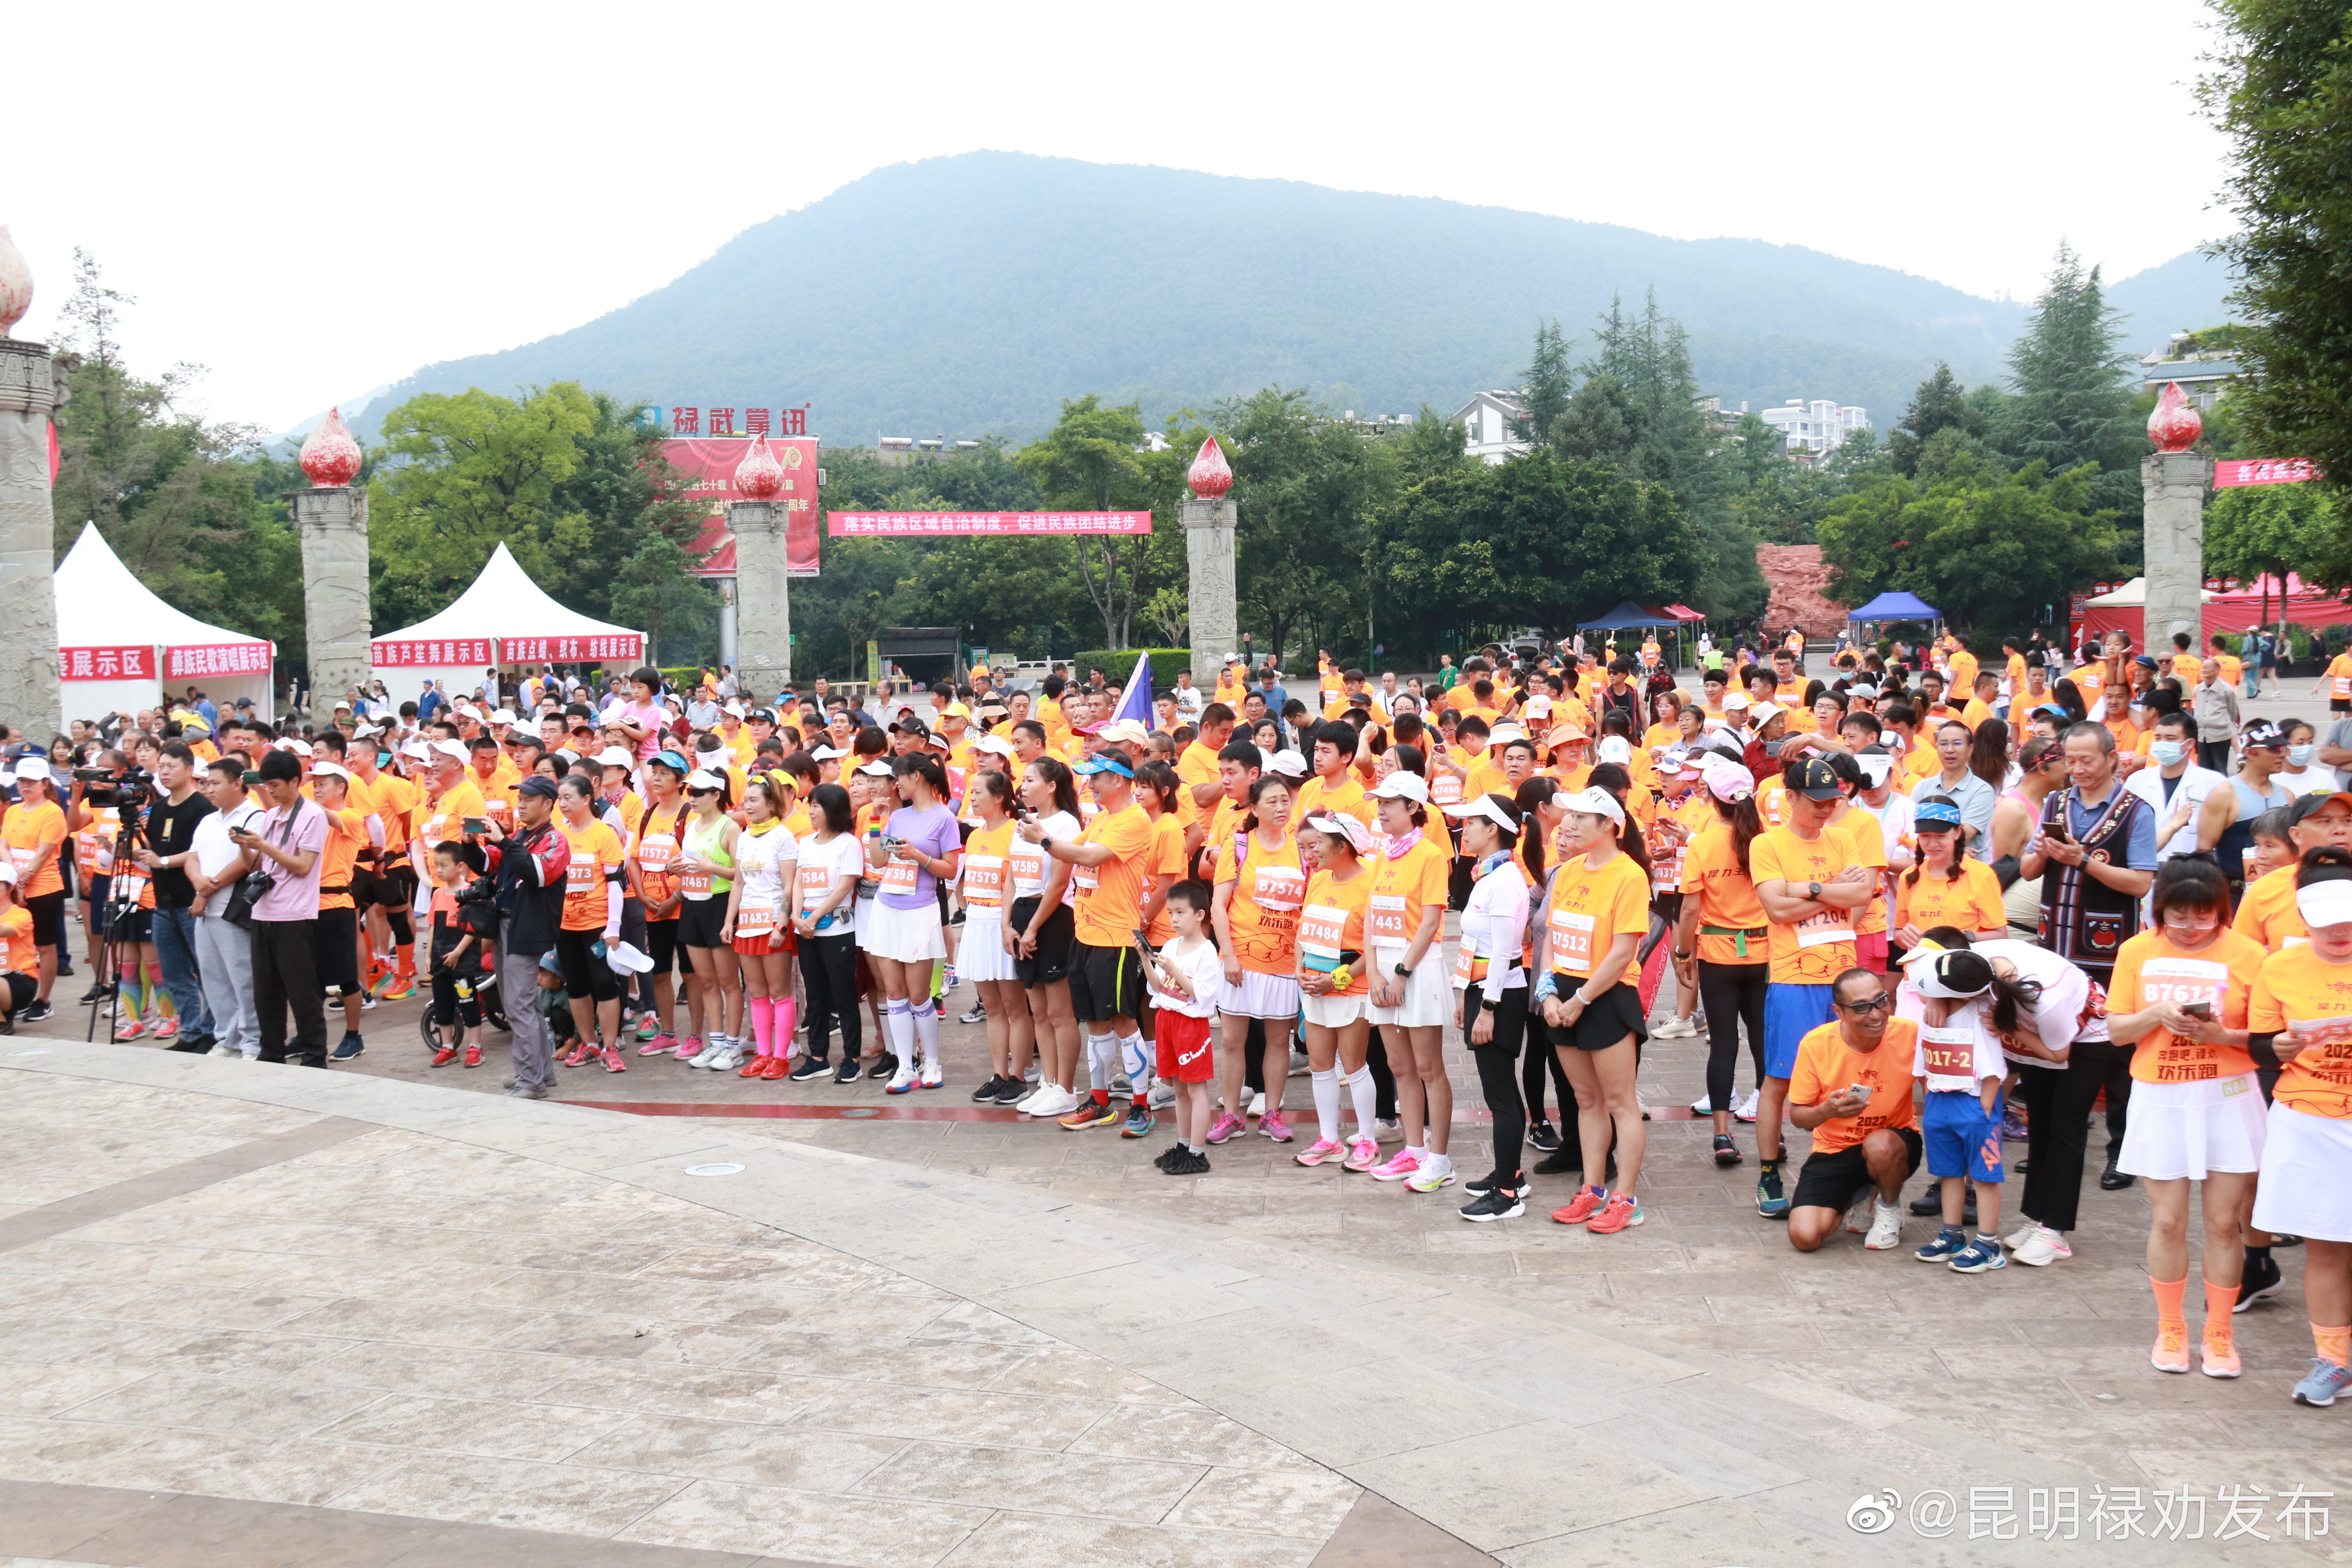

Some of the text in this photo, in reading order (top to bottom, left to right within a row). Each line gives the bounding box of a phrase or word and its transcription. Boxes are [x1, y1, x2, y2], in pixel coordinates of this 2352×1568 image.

[673, 407, 806, 434] 禄武掌讯
[373, 642, 486, 664] 苗族芦笙舞展示区
[507, 638, 636, 661] 苗族点蜡、织布、纺线展示区
[172, 646, 268, 676] 彝族民歌演唱展示区
[1434, 786, 1460, 795] B7490
[639, 846, 669, 859] B7572
[1012, 860, 1038, 873] B7589
[1707, 868, 1743, 878] 犀力王
[885, 867, 914, 881] B7598
[964, 870, 998, 884] B7579
[682, 875, 708, 888] B7487
[1258, 880, 1303, 898] B7574
[739, 912, 770, 924] B7482
[1259, 915, 1293, 929] 欢乐跑
[1302, 924, 1339, 941] B7484
[1553, 930, 1587, 952] B7512
[2324, 1044, 2352, 1058] 202
[2157, 1064, 2217, 1080] 欢乐跑
[1857, 1116, 1887, 1127] 2022
